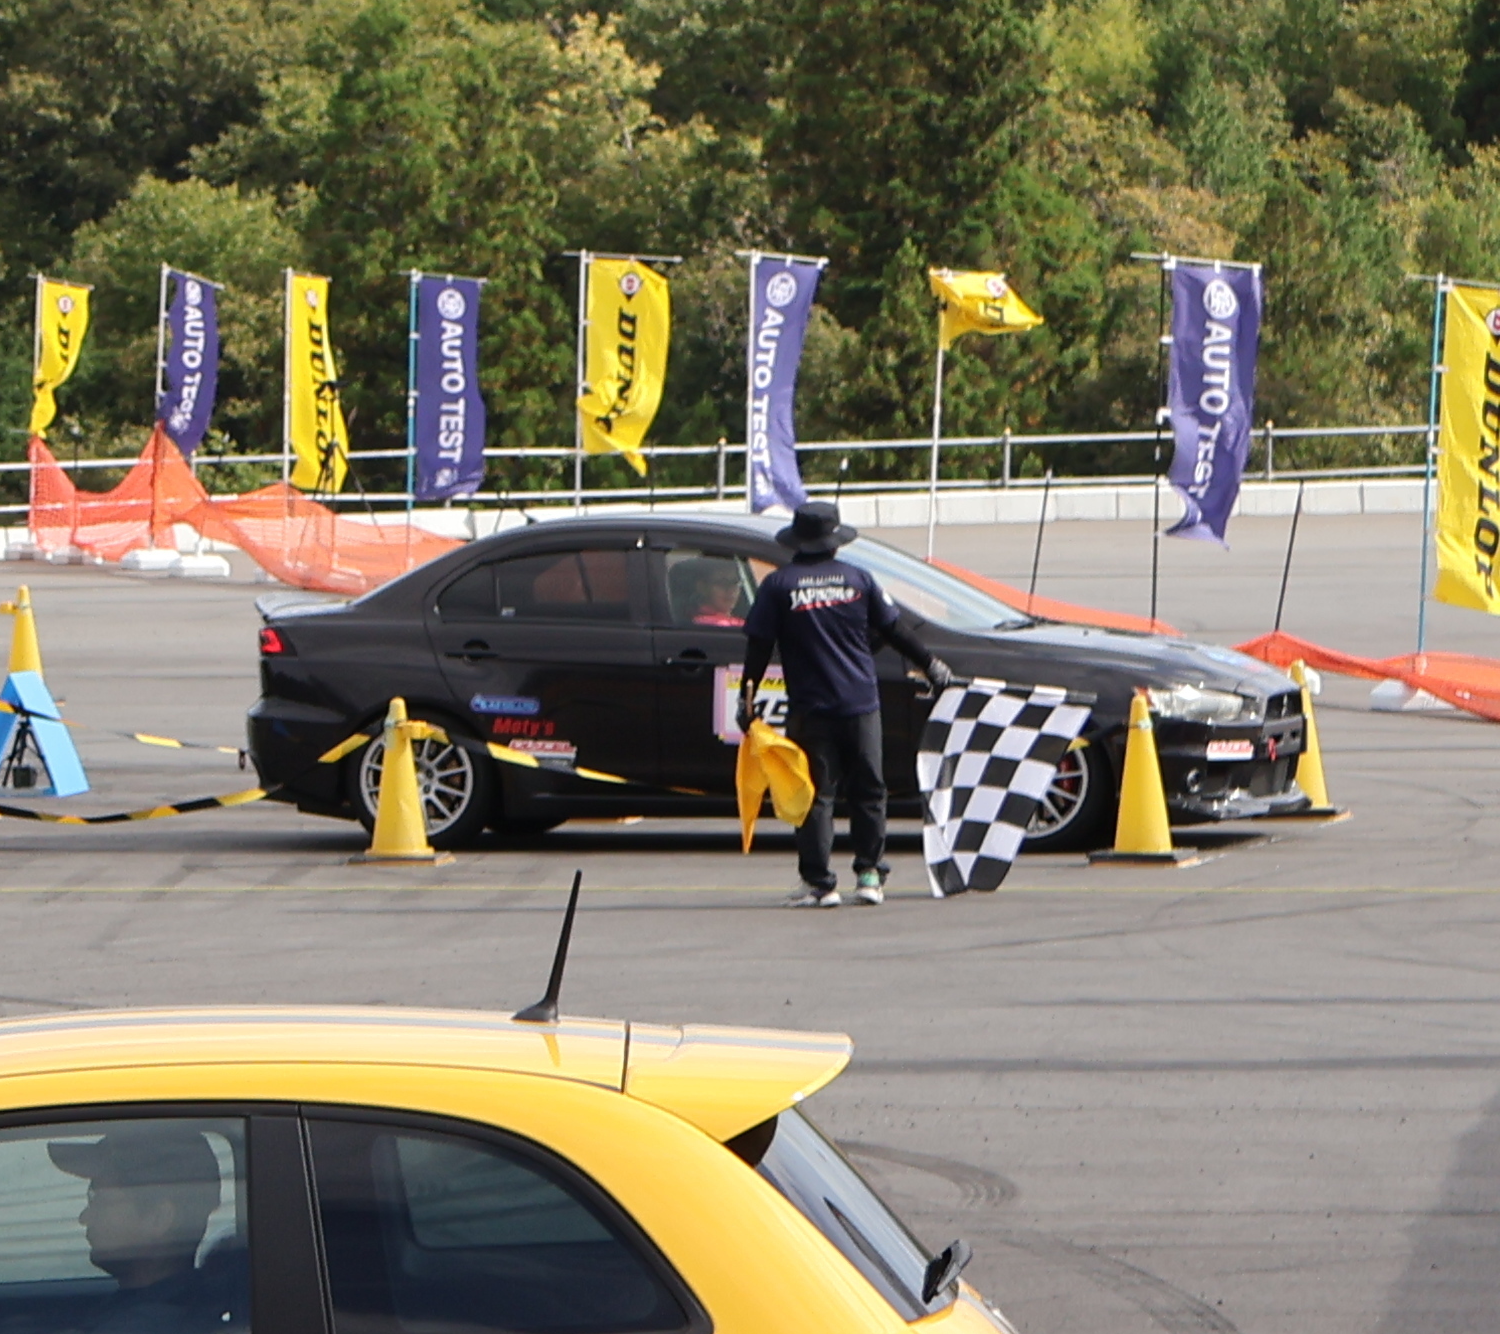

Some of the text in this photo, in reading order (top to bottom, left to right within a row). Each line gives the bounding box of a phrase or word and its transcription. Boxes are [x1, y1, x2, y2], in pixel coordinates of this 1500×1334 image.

[181, 306, 205, 369] AUTO
[440, 320, 466, 394] AUTO
[753, 307, 784, 389] AUTO
[1199, 319, 1233, 416] AUTO
[438, 397, 466, 464] TEST
[752, 394, 772, 469] TEST
